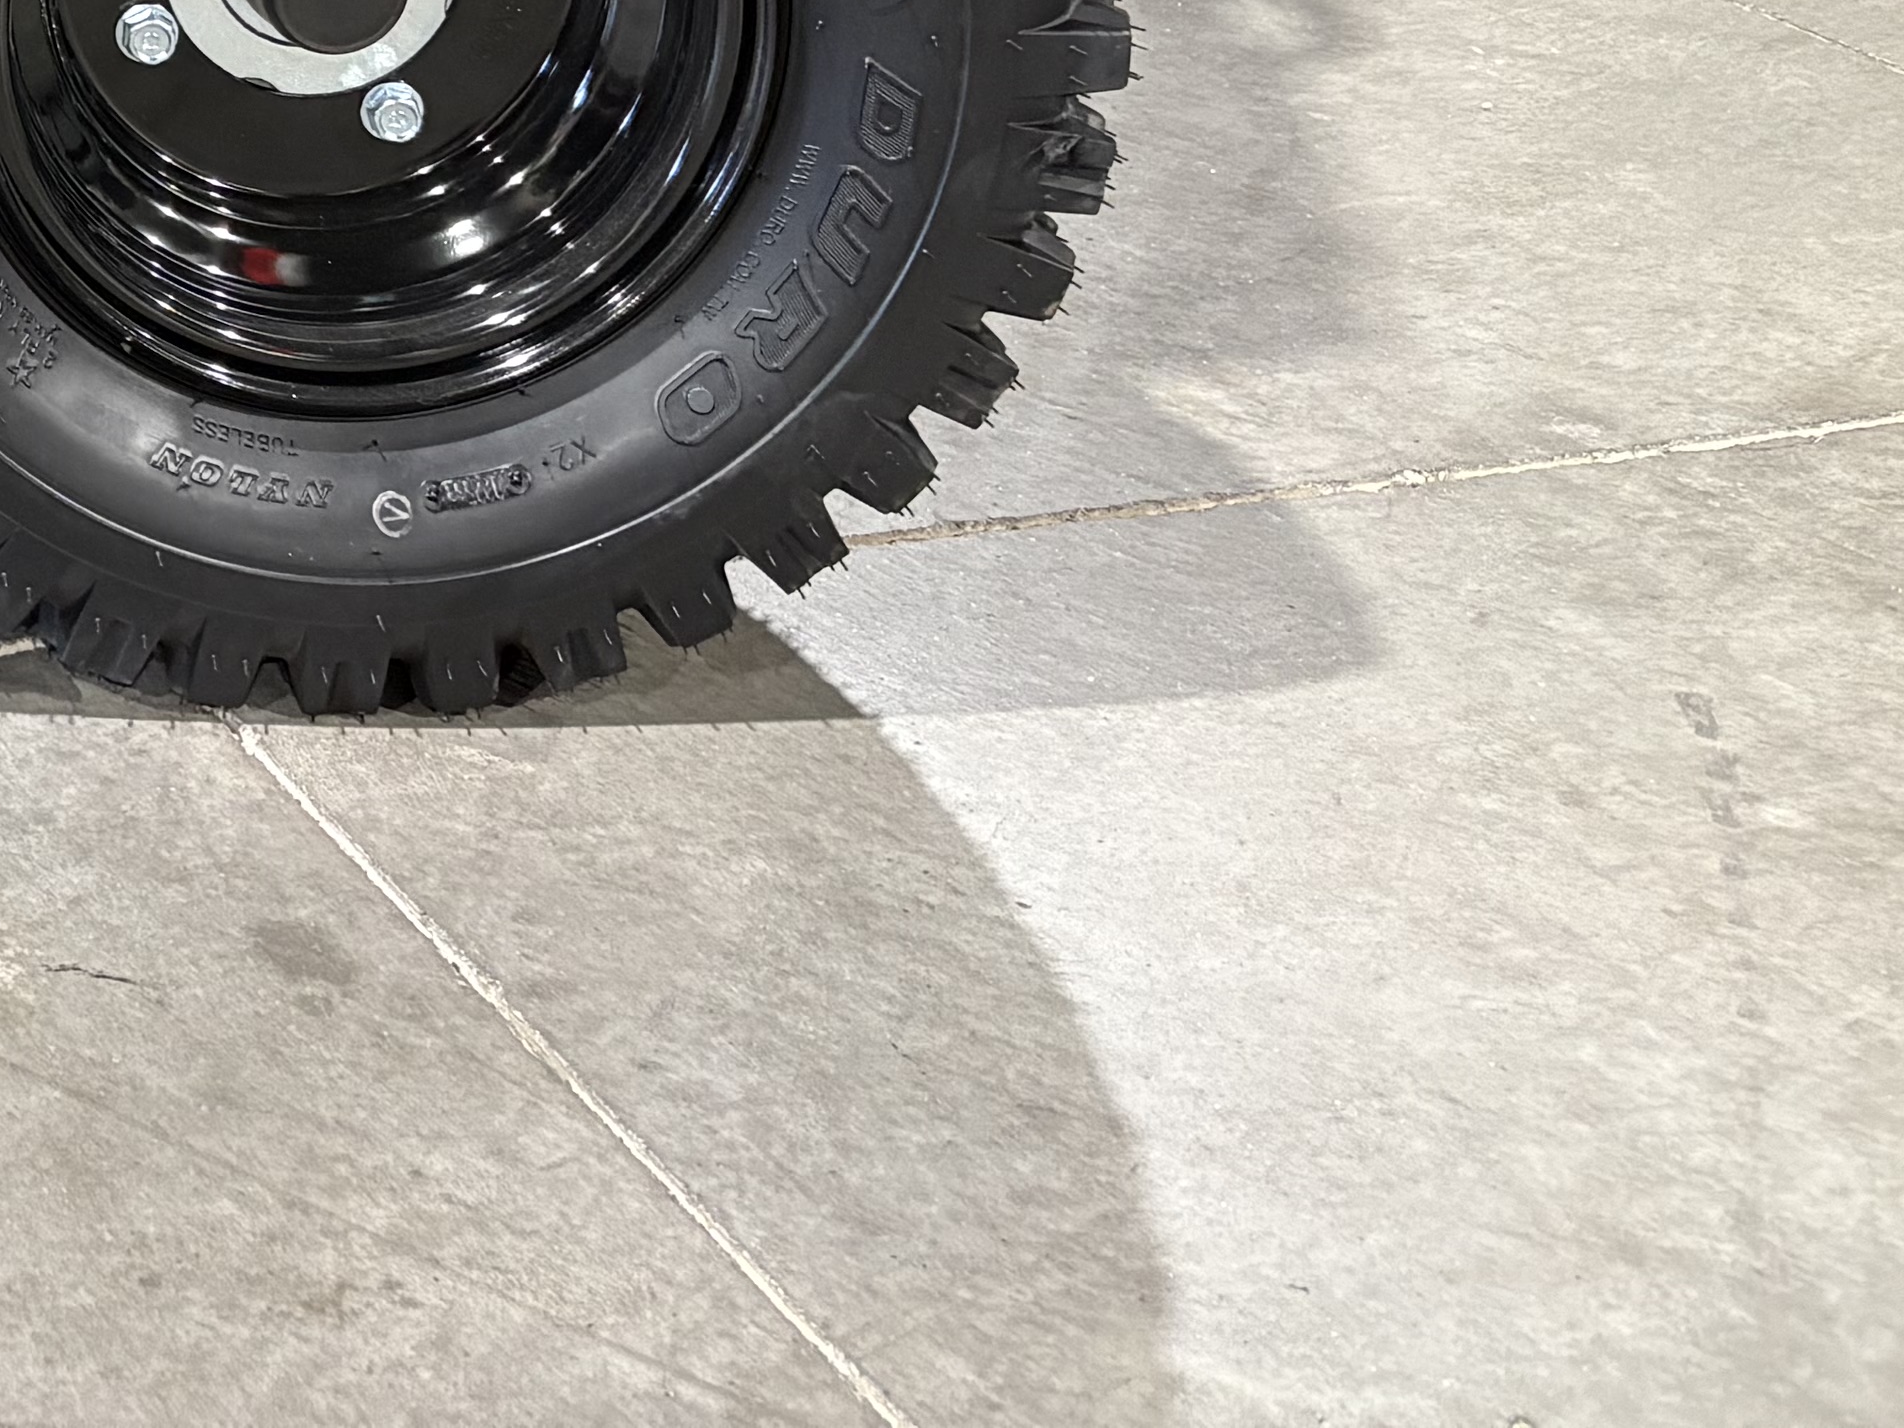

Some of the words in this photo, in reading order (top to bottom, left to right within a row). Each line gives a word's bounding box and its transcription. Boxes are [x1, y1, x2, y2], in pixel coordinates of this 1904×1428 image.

[654, 56, 923, 446] DURO
[194, 415, 299, 457] TUBELESS
[150, 441, 337, 511] NYLON
